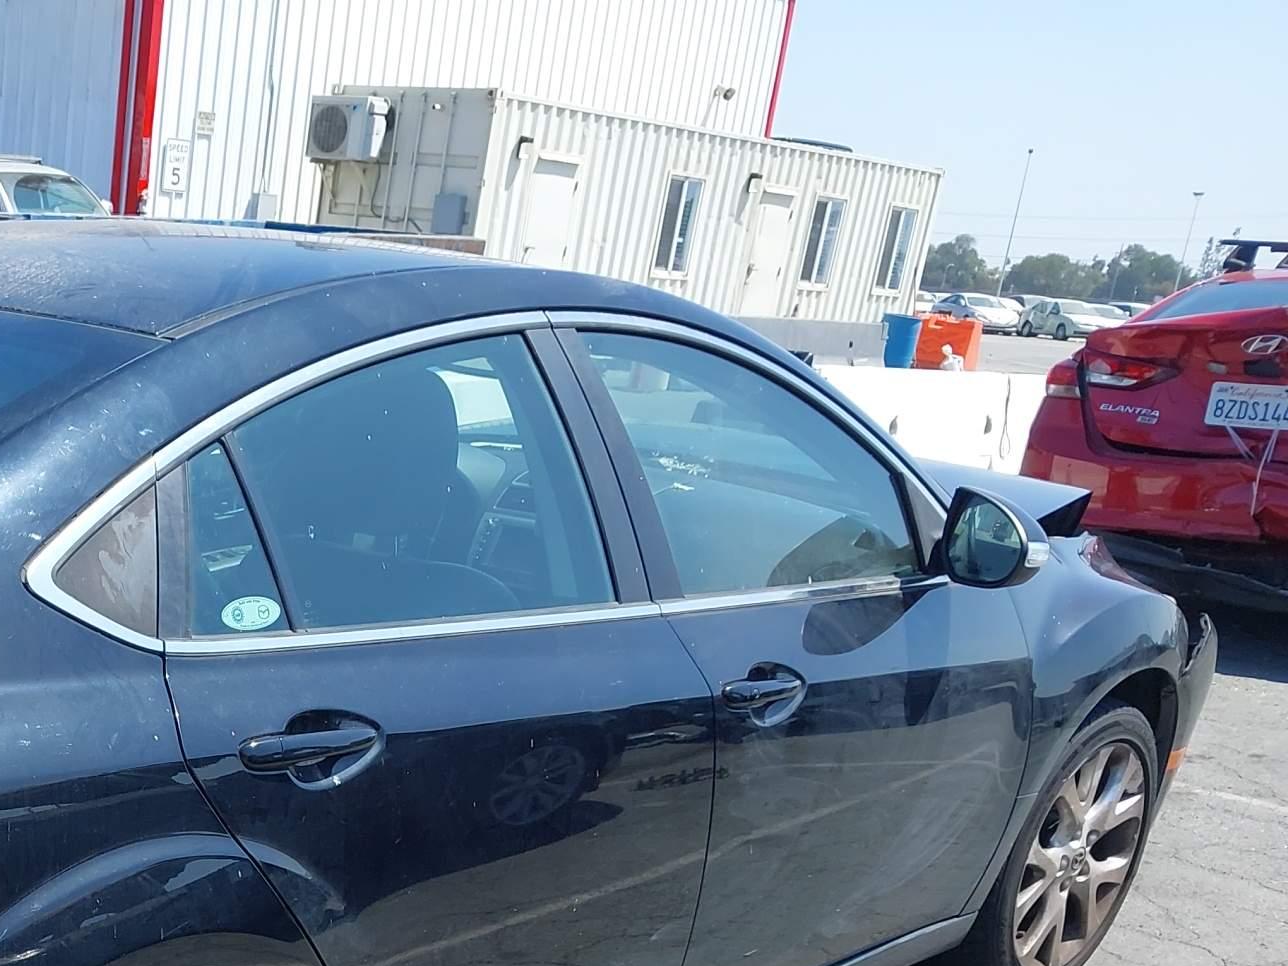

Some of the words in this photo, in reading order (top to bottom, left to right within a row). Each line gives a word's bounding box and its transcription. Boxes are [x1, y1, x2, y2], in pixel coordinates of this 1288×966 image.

[168, 143, 189, 153] SPEED
[170, 167, 181, 186] 5
[1099, 403, 1160, 417] ELANTRA
